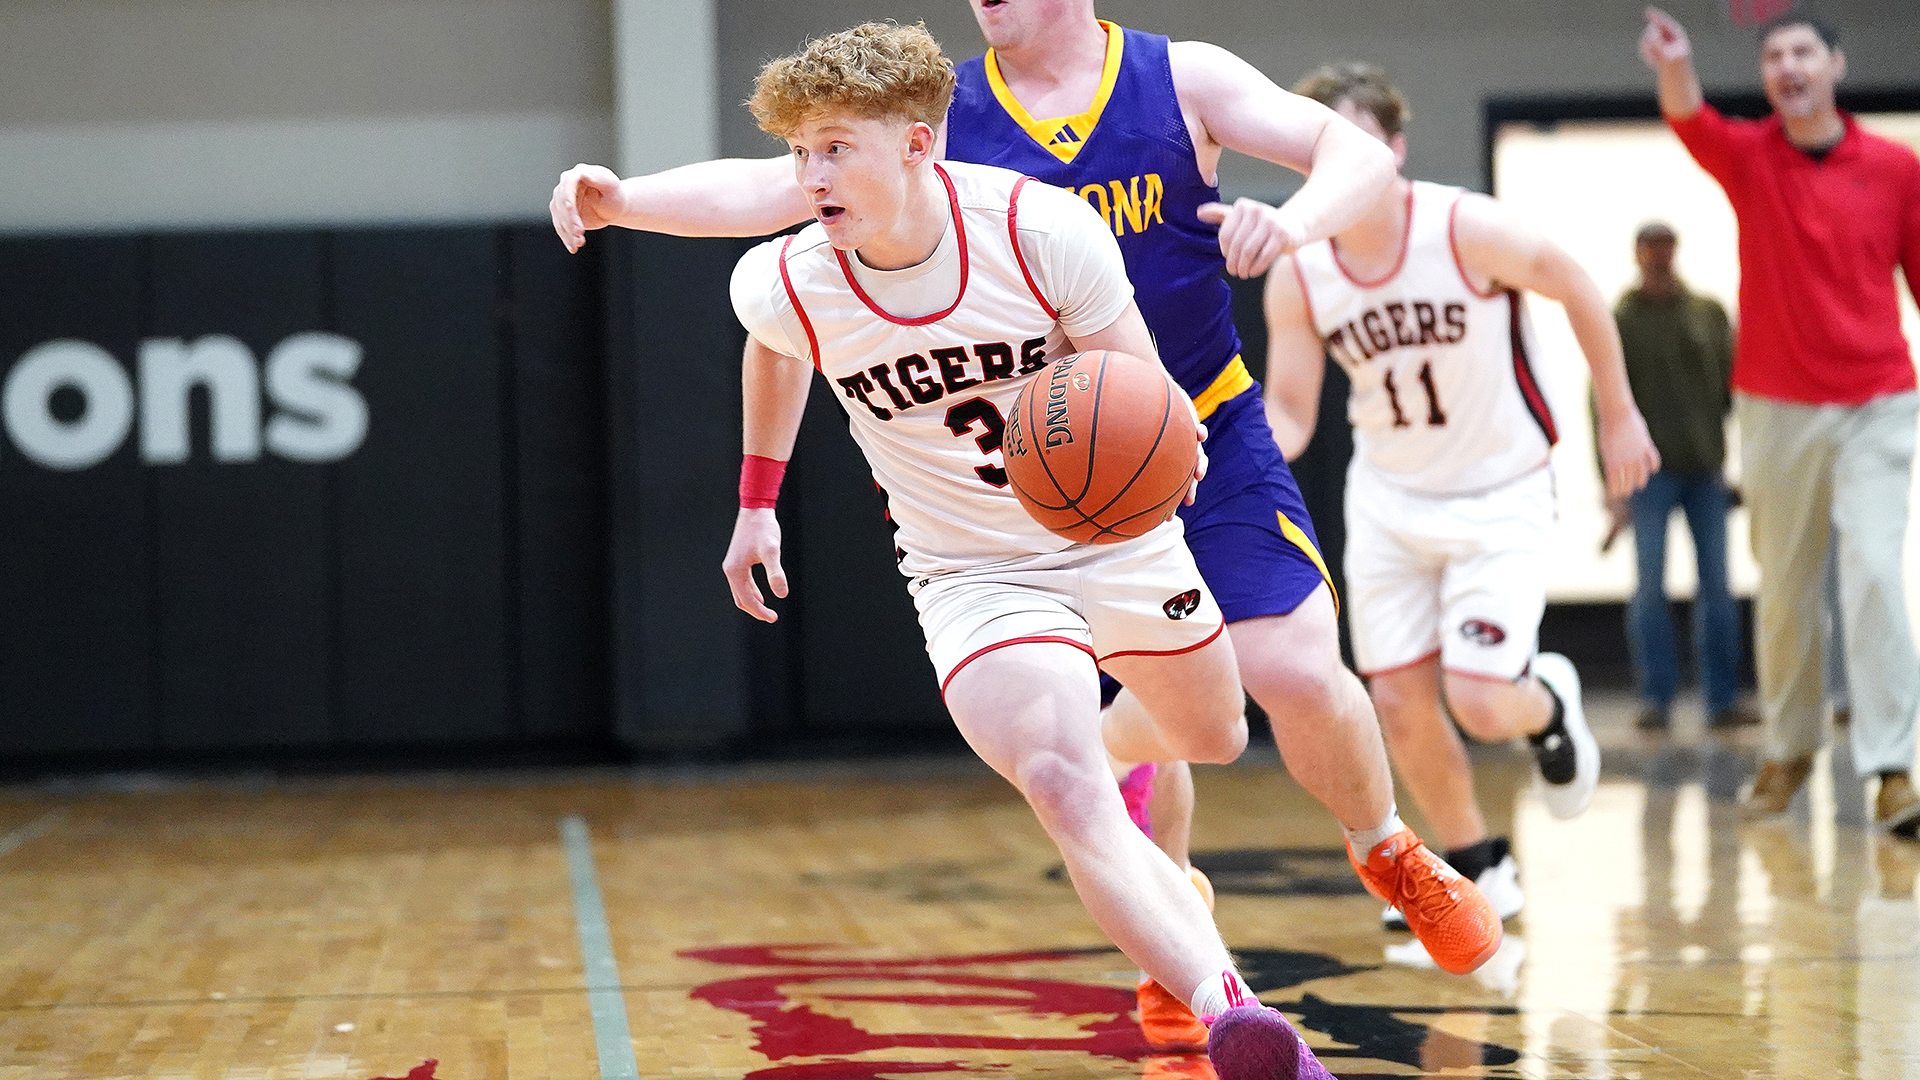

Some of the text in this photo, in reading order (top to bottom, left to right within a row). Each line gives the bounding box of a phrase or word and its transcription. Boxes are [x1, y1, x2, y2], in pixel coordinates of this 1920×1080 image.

[1065, 173, 1164, 237] ONA
[1326, 301, 1465, 366] TIGERS
[837, 337, 1049, 422] TIGERS
[1384, 361, 1446, 427] 11
[943, 397, 1009, 489] 3
